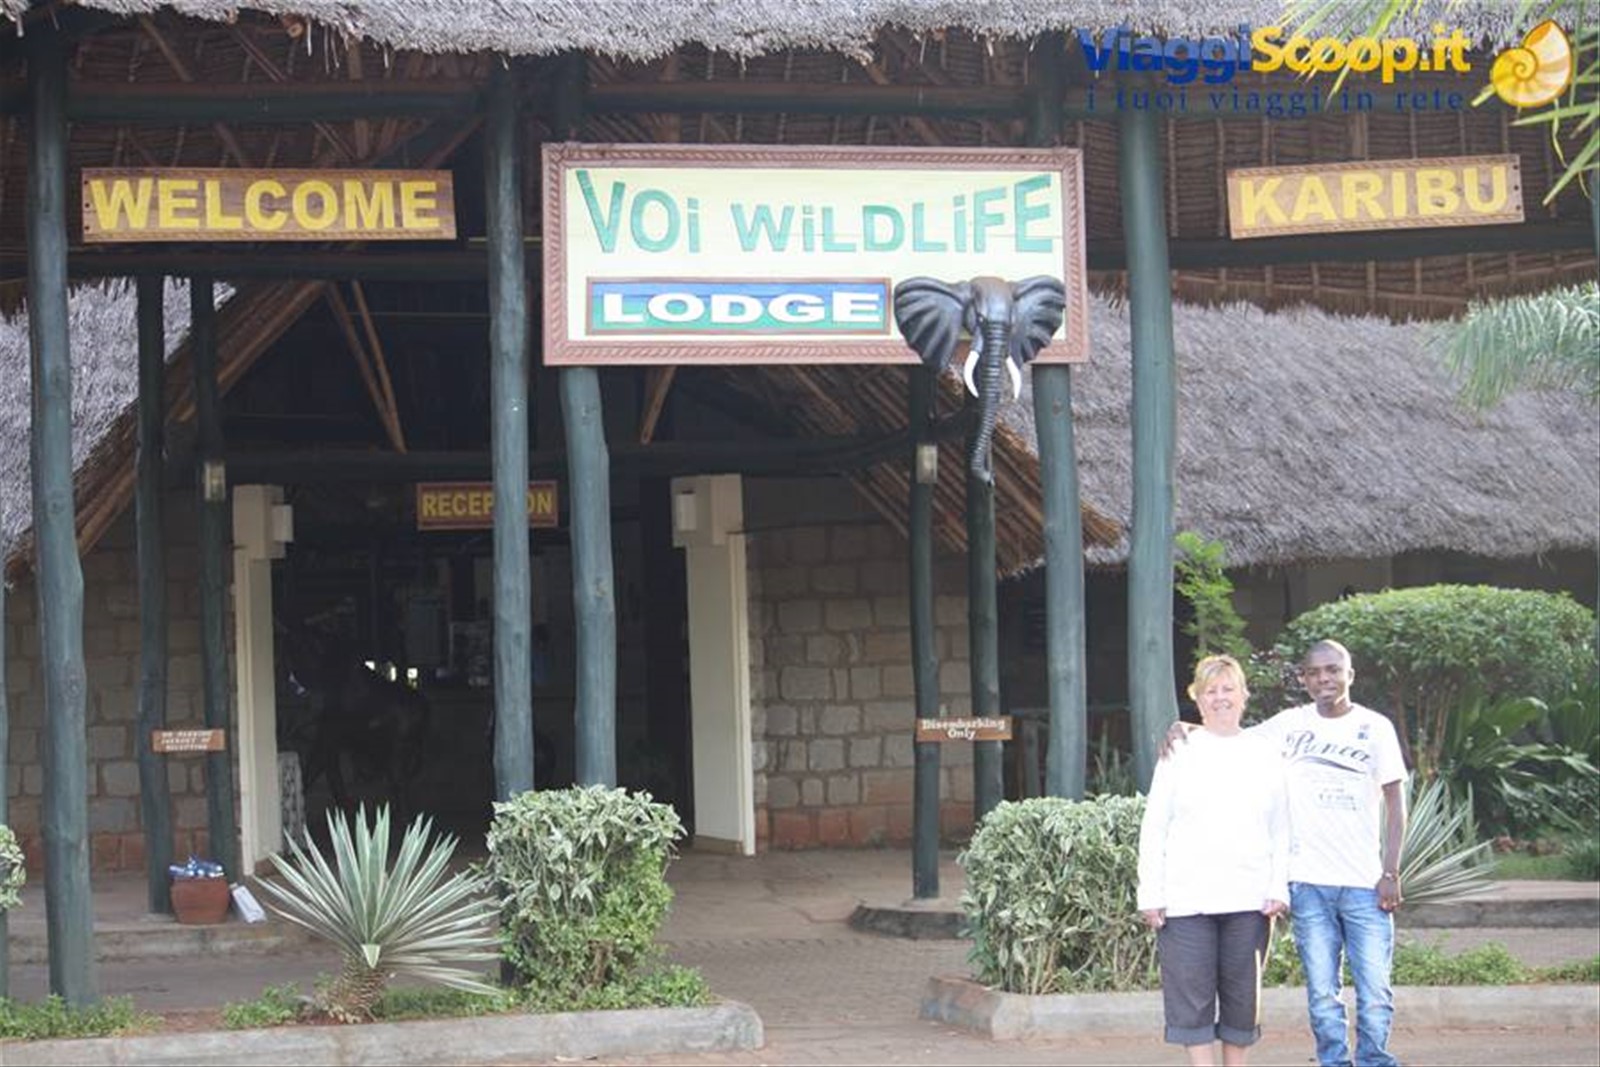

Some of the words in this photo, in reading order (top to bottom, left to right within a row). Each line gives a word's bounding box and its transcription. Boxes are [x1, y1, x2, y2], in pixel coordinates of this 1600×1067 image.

[89, 178, 441, 231] WELCOME
[1238, 165, 1508, 226] KARIBU
[603, 291, 881, 323] LODGE
[422, 490, 553, 517] RECEPON
[947, 728, 976, 740] Only
